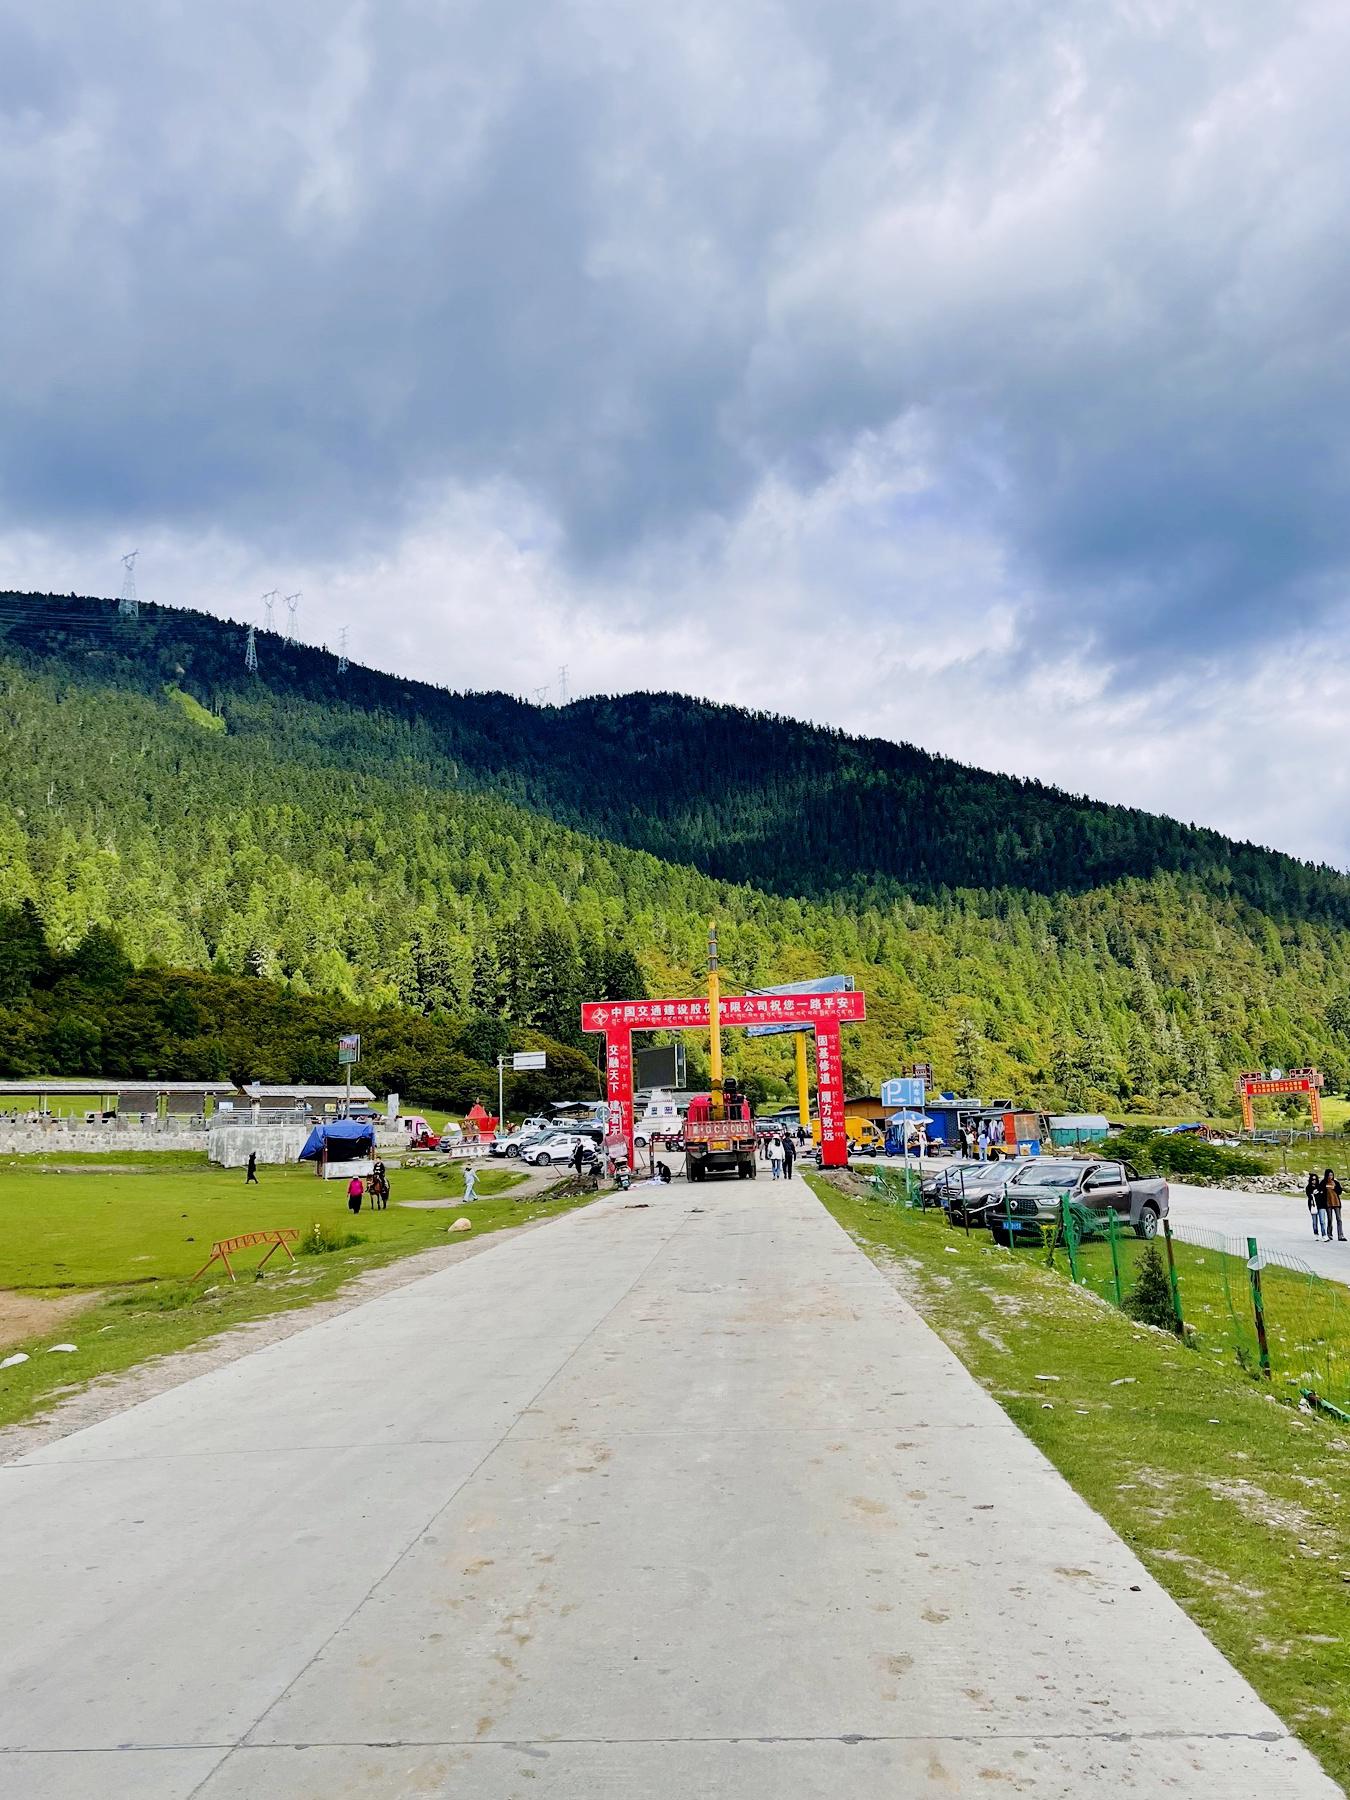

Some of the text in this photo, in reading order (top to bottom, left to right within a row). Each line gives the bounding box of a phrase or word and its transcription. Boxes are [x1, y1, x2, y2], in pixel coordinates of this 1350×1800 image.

[608, 1044, 620, 1093] 交融天下
[887, 1081, 901, 1104] P
[821, 1091, 835, 1141] 履方致远
